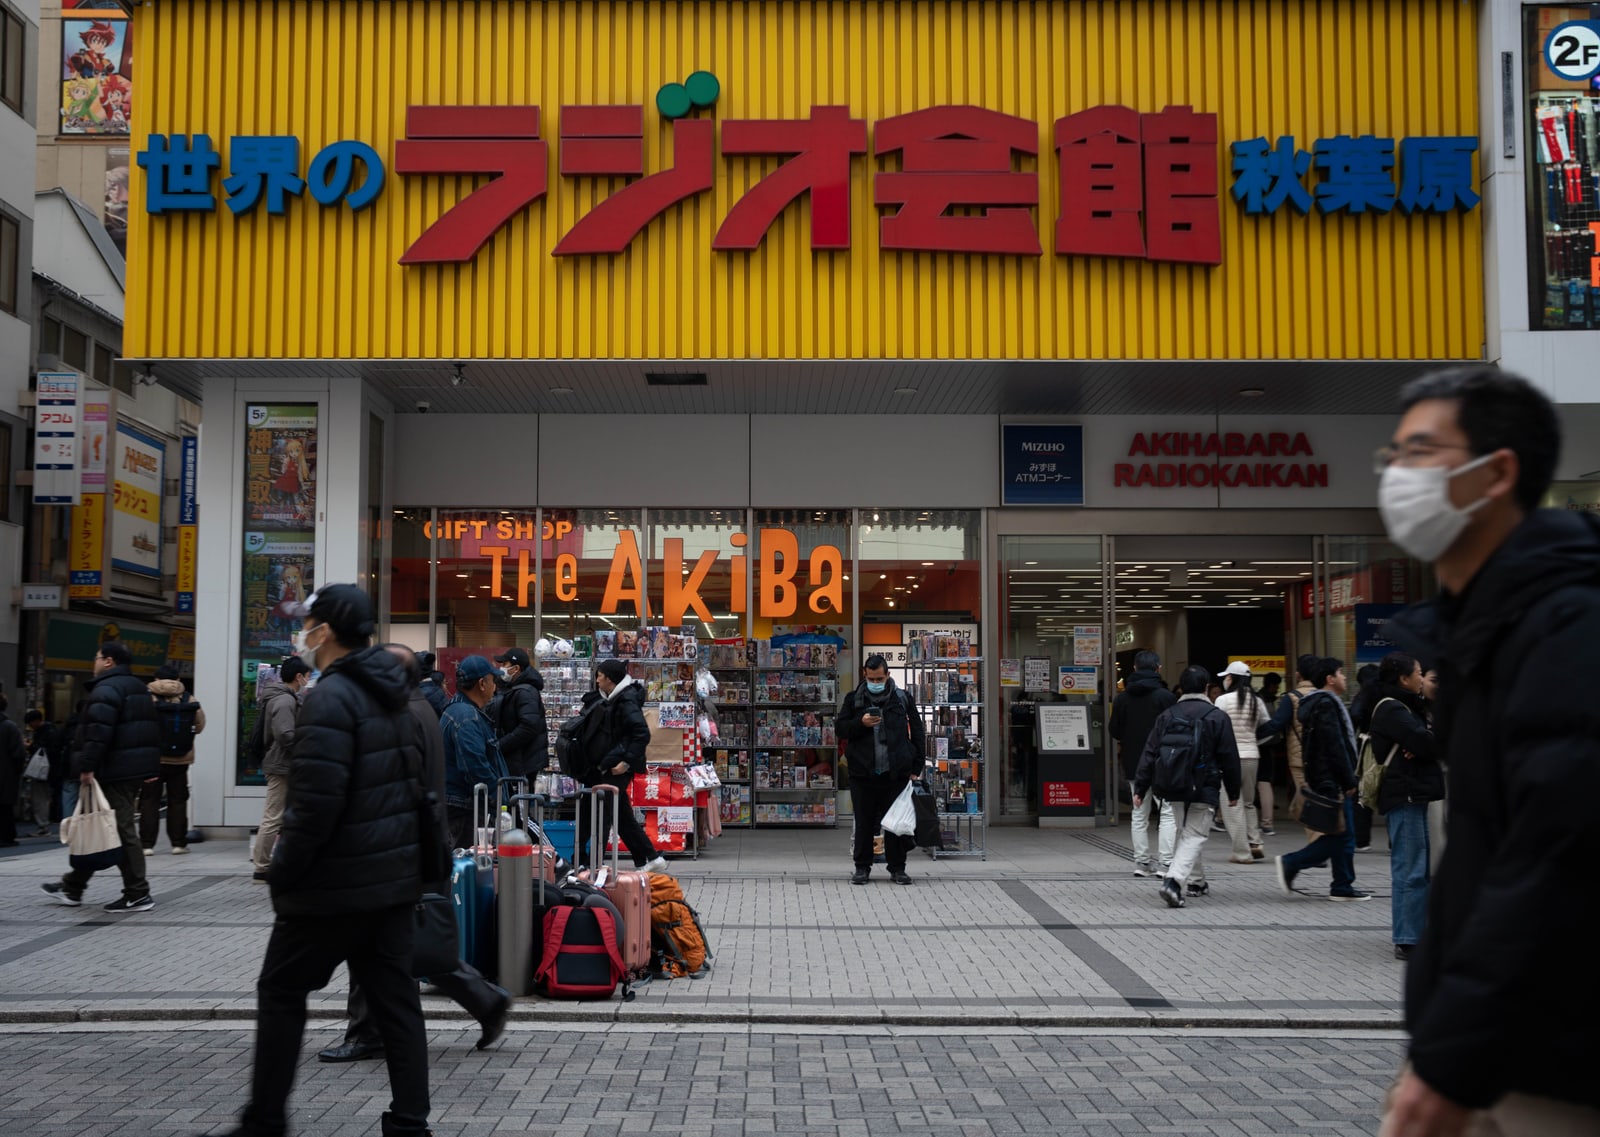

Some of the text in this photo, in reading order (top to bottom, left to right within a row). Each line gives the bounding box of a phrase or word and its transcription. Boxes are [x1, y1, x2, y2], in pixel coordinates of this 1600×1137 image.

[1553, 35, 1600, 67] 2F
[137, 70, 1482, 266] 世界の ラジオ会館 秋葉原
[40, 413, 73, 424] アコム
[252, 409, 266, 420] 5F
[1021, 441, 1065, 452] MIZUHO
[1128, 431, 1313, 457] AKIHABARA
[1029, 462, 1057, 472] みずほ
[1113, 463, 1329, 488] RADIOKAIKAN
[1014, 473, 1072, 483] ATMコーナー
[80, 497, 94, 569] カードラッシュ
[249, 535, 264, 545] 5F
[423, 520, 573, 540] GIFT SHOP
[479, 546, 578, 608] The
